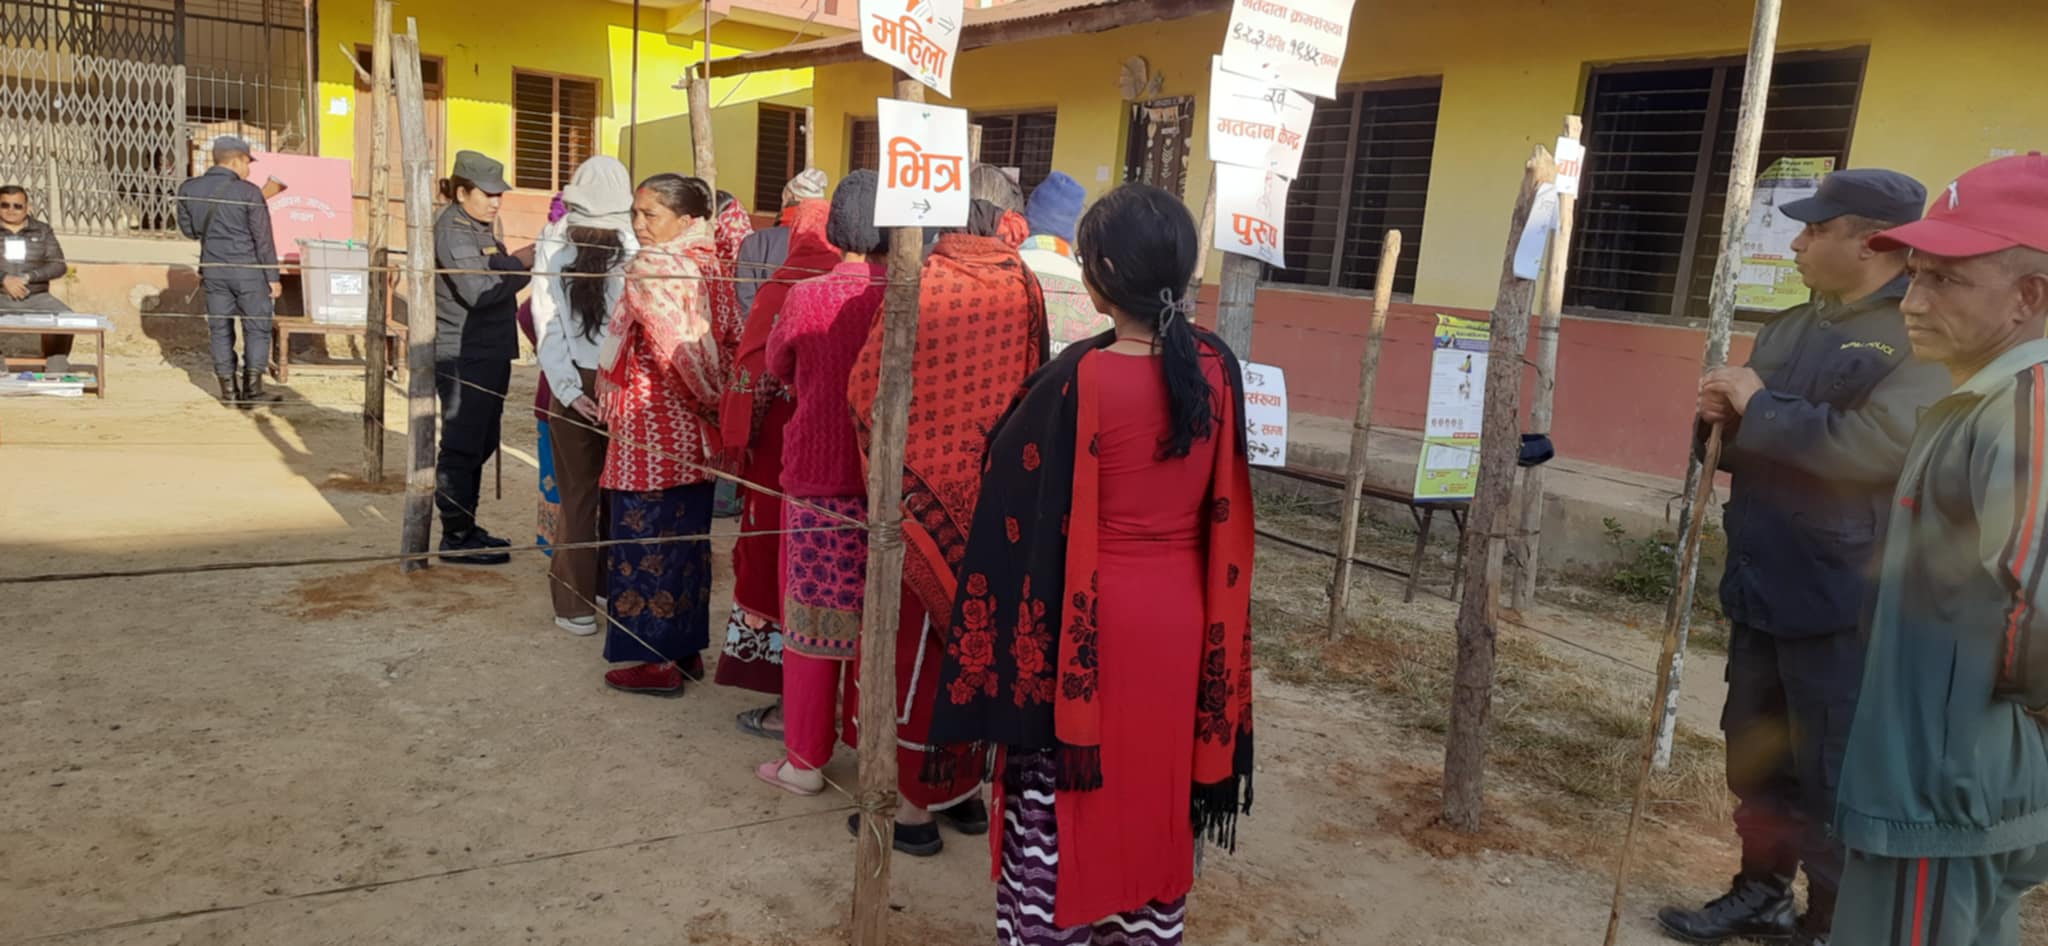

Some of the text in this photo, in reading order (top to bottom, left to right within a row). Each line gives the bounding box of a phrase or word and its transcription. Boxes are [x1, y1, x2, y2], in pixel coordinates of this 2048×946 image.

[871, 13, 949, 80] महिला
[1217, 117, 1302, 151] मतदान केन्द्र
[887, 136, 963, 193] भित्र
